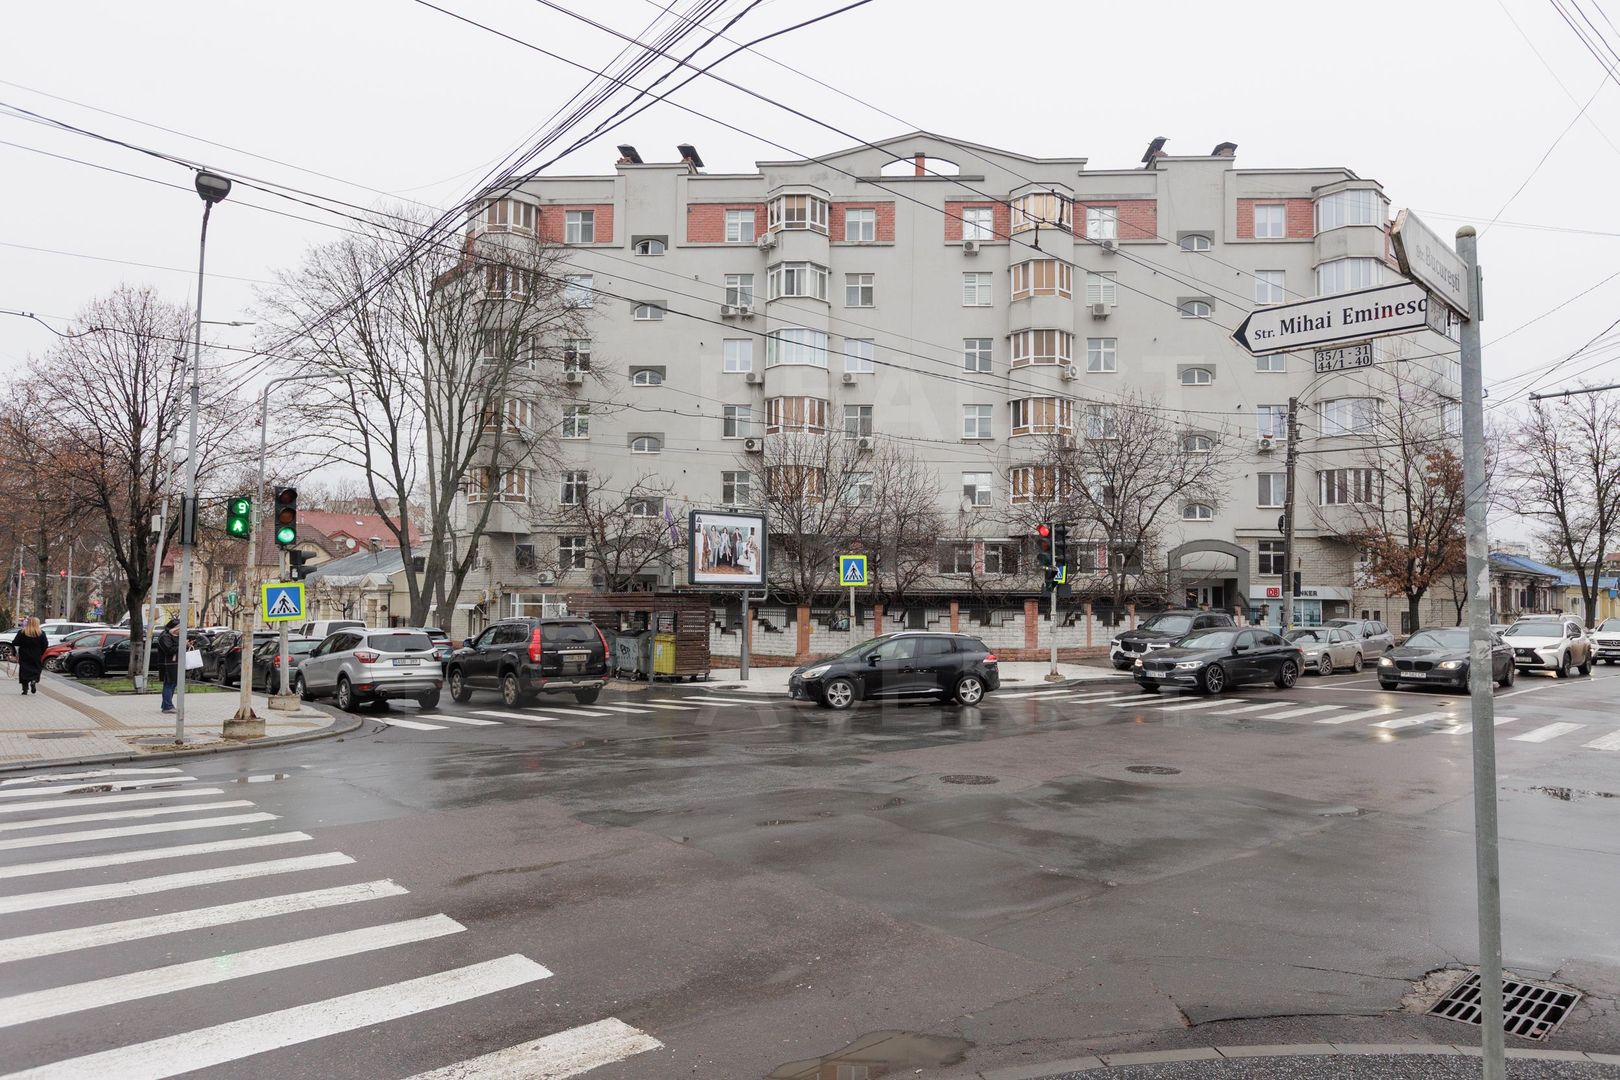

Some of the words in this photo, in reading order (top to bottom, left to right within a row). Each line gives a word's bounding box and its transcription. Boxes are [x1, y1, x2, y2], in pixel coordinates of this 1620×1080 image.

[1254, 327, 1276, 341] Str.
[1279, 311, 1332, 336] Mihai
[1342, 298, 1427, 326] Eminesc
[1318, 350, 1344, 362] 35/1
[1355, 345, 1369, 356] 31
[1318, 359, 1344, 371] 44/1
[1355, 355, 1370, 366] 40
[1267, 588, 1279, 596] DB
